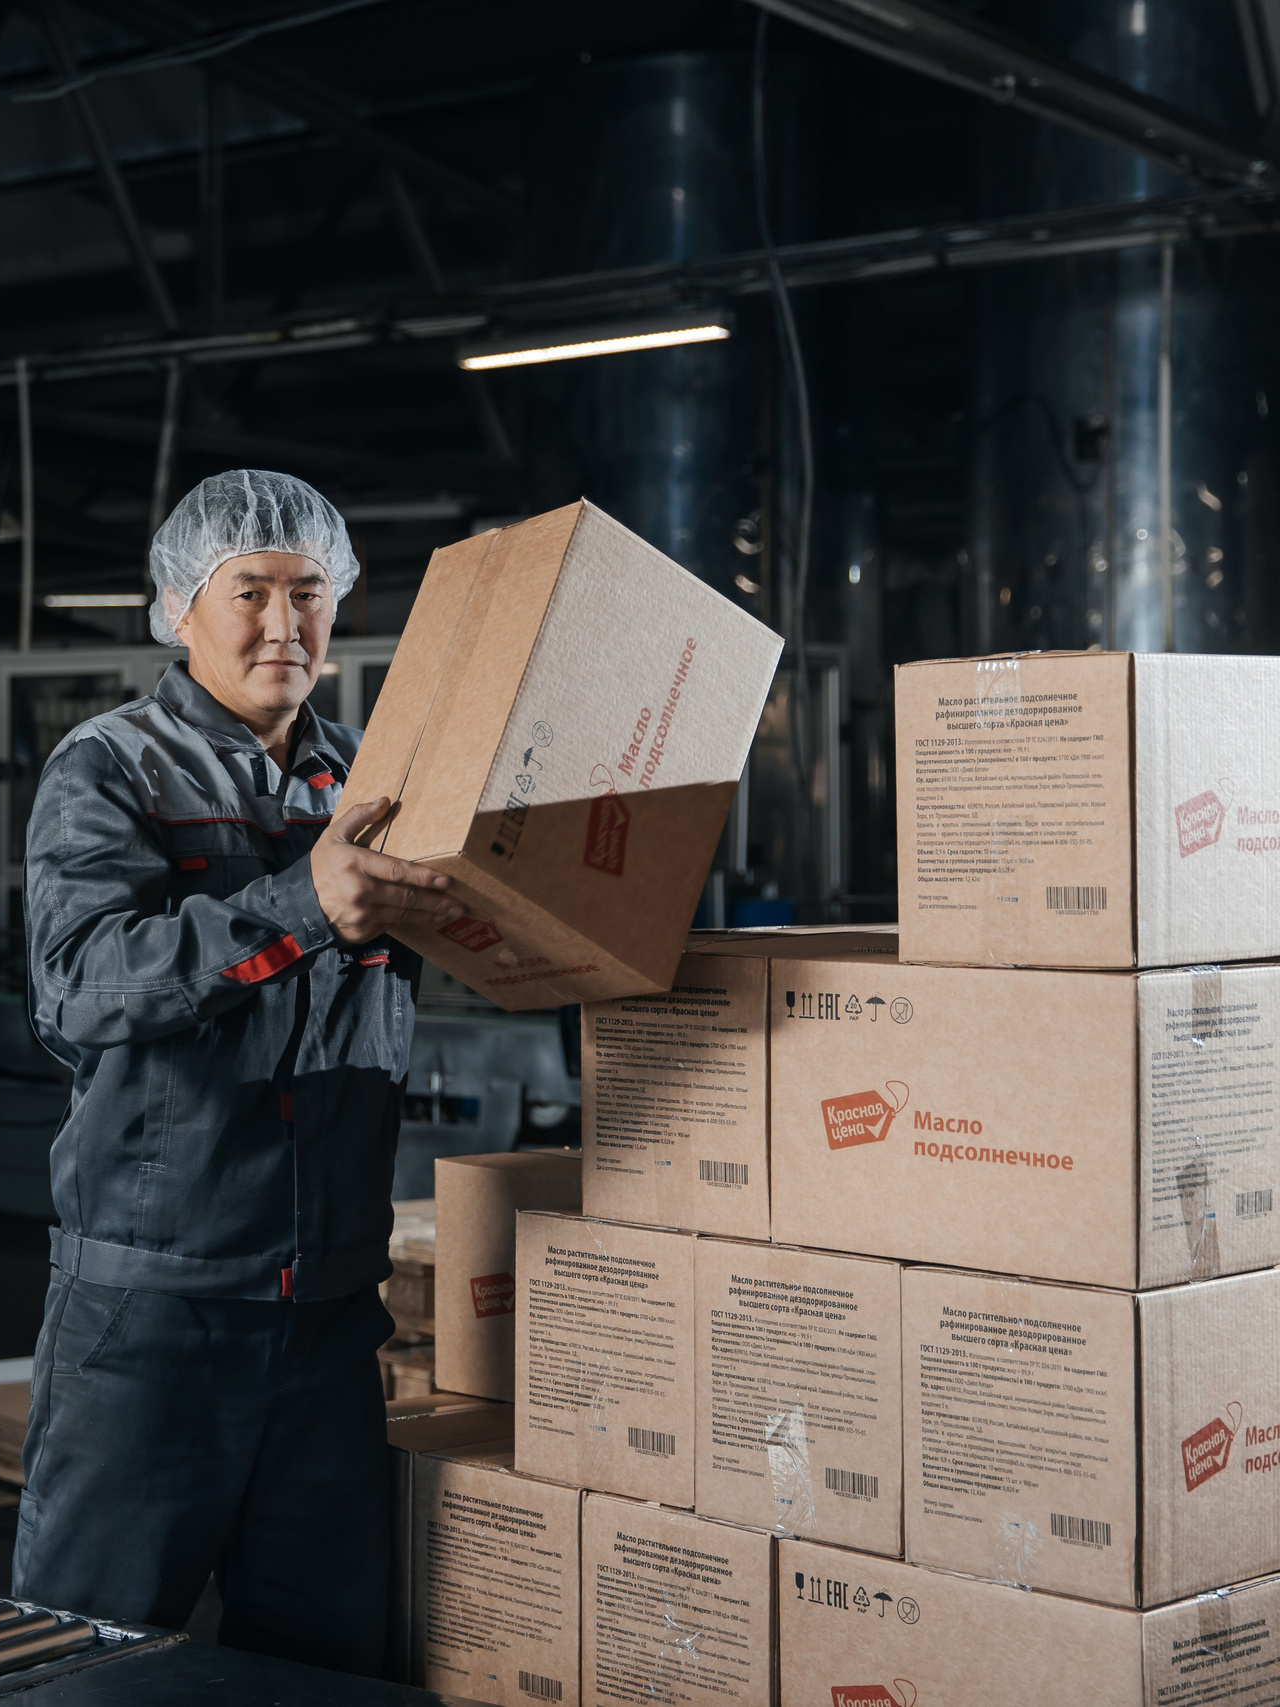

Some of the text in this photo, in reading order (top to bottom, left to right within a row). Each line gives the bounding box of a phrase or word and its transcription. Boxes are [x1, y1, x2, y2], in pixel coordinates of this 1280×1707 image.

[639, 637, 697, 789] подсолнечное
[938, 694, 1077, 707] Масло растительное подсолнечное
[935, 706, 1082, 721] рафинированное дезодорированное
[946, 722, 981, 730] высшего
[1006, 719, 1043, 730] «Красная
[1045, 719, 1069, 728] цена»
[618, 706, 651, 777] Масло
[915, 739, 929, 747] ГОСТ
[930, 738, 964, 747] 1129-2013.
[1178, 803, 1220, 831] Красная
[1237, 806, 1280, 825] Масло
[1182, 826, 1205, 848] цена
[621, 1005, 649, 1013] высшего
[650, 1007, 667, 1015] сорта
[818, 993, 840, 1020] EAC
[827, 1102, 884, 1125] Красная
[914, 1110, 983, 1136] Масло
[831, 1122, 866, 1142] цена
[914, 1141, 1074, 1171] подсолнечное
[545, 1257, 659, 1281] рафинированное дезодорированное
[548, 1245, 655, 1269] Масло растительное подсолнечное
[529, 1279, 540, 1287] ГОСТ
[554, 1270, 648, 1289] высшего сорта «Красная цена»
[732, 1274, 854, 1299] Масло растительное подсолнечное
[477, 1298, 501, 1312] цена
[729, 1287, 858, 1312] рафинированное дезодорированное
[739, 1300, 846, 1321] высшего сорта «Красная цена»
[712, 1310, 724, 1318] ГОСТ
[943, 1306, 1081, 1333] Масло растительное подсолнечное
[940, 1320, 1086, 1347] рафинированное дезодорированное
[951, 1334, 1073, 1356] высшего сорта «Красная цена»
[920, 1344, 934, 1353] ГОСТ
[1071, 1368, 1096, 1377] содержит
[1185, 1429, 1226, 1466] Красная
[1188, 1455, 1213, 1482] цена
[442, 1501, 547, 1532] рафинированное дезодорированное
[444, 1489, 543, 1520] Масло растительное подсолнечное
[450, 1513, 537, 1539] высшего сорта «Красная цена»
[613, 1543, 733, 1578] рафинированное дезодорированное
[616, 1531, 729, 1566] Масло растительное подсолнечное
[597, 1564, 608, 1573] ГОСТ
[623, 1557, 721, 1586] высшего сорта «Красная цена»
[826, 1579, 849, 1610] EAC
